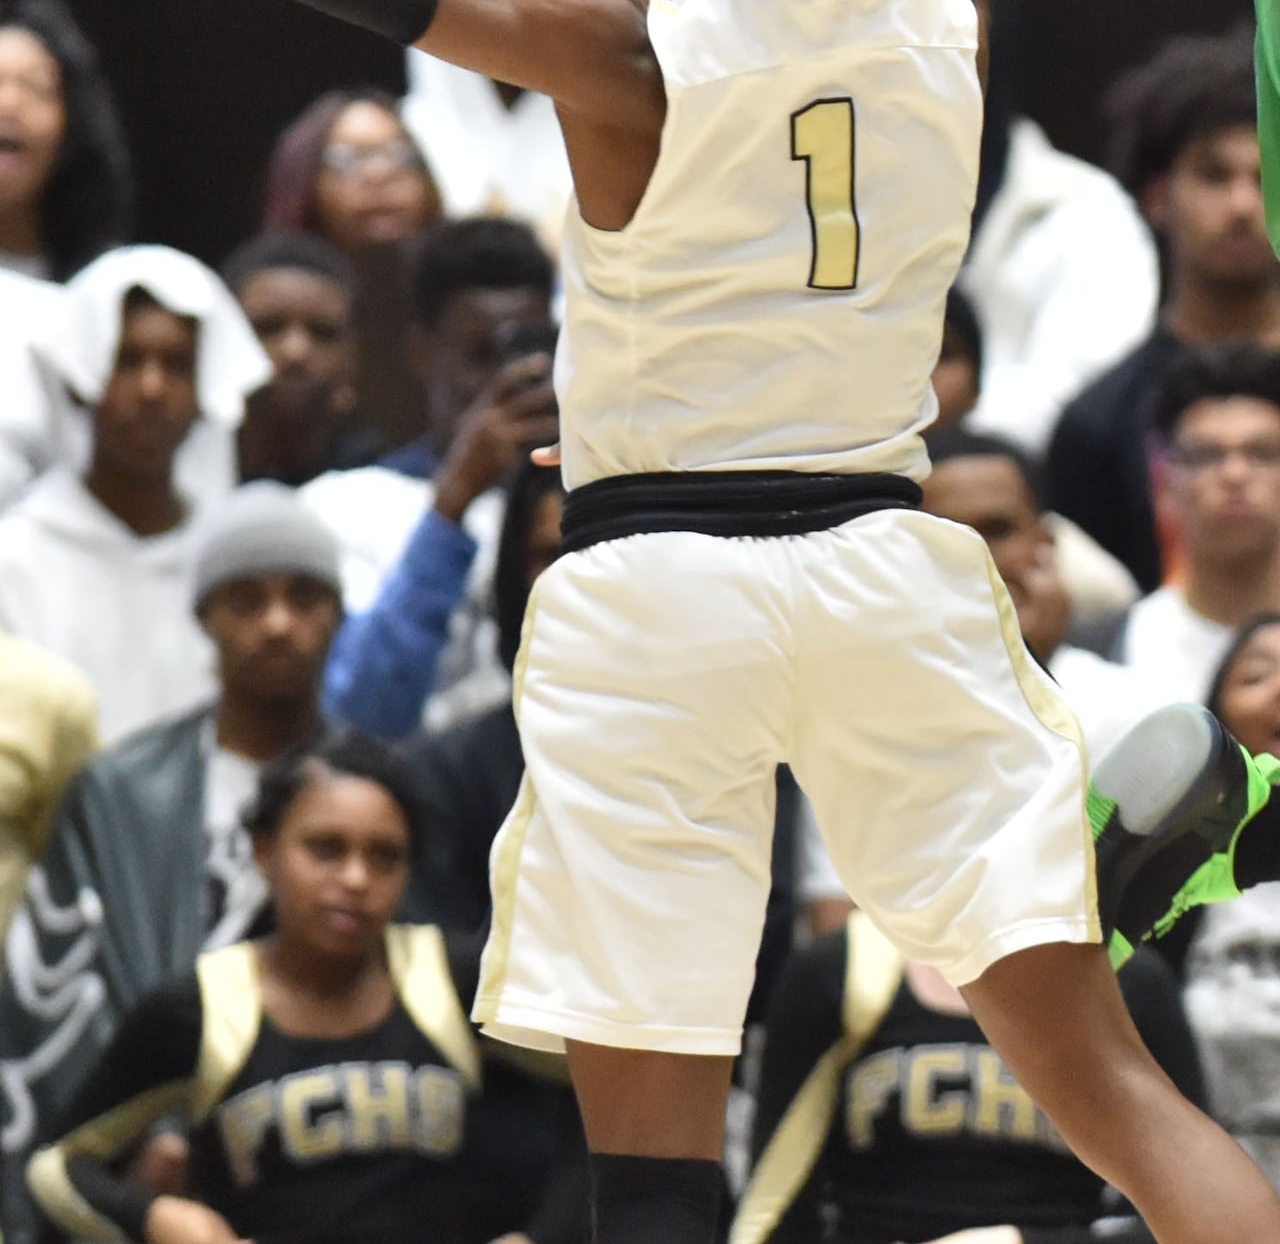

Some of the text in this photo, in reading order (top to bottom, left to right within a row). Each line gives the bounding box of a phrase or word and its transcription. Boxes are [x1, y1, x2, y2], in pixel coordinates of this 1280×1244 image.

[790, 97, 860, 290] 1
[217, 1058, 467, 1187] FCHS
[846, 1040, 1075, 1154] FCH
